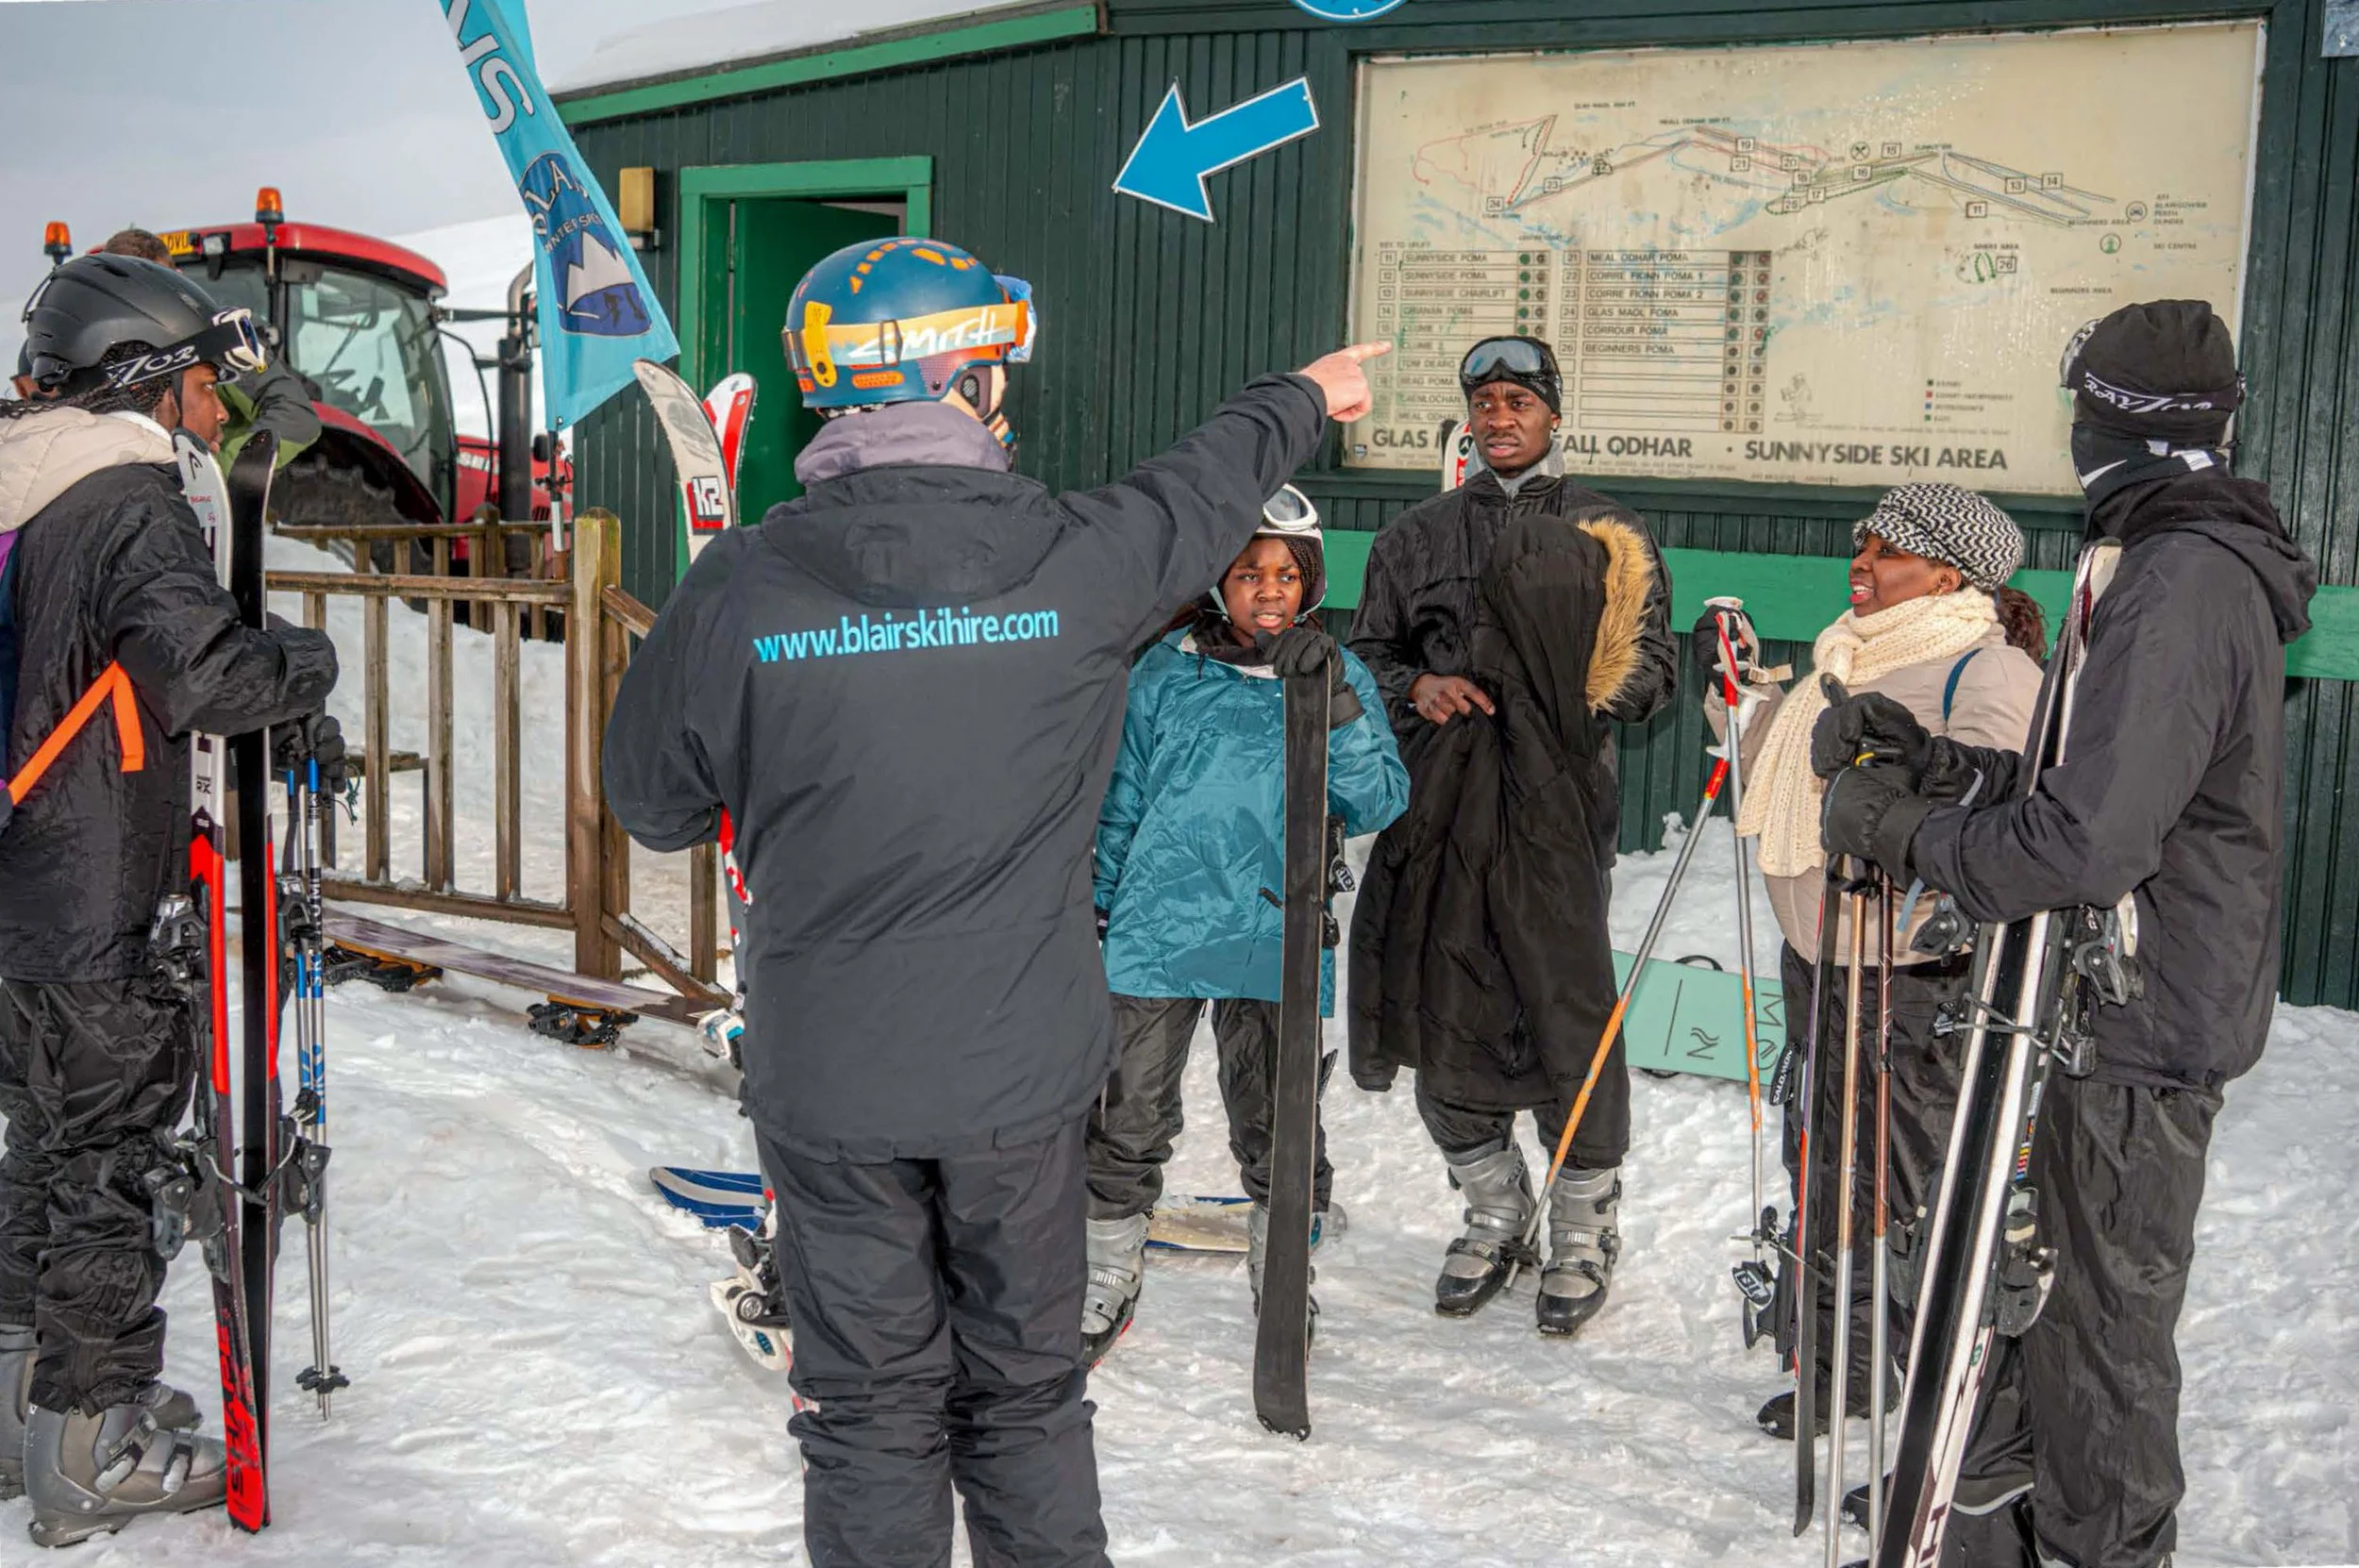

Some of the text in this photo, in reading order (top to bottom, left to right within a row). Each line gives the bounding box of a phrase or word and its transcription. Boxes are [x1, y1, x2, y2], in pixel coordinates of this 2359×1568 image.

[1459, 289, 1507, 298] CHAIRLIFT
[1663, 290, 1693, 299] POMA
[1587, 308, 1614, 317] GLAS
[1585, 344, 1641, 354] BEGINNERS
[1645, 344, 1675, 354] POMA
[1373, 428, 1429, 449] GLAS
[1606, 435, 1693, 458] ODHAR
[1745, 440, 1882, 466] SUNNYSIDE
[1889, 444, 1930, 467] SKI
[1935, 447, 2008, 470] AREA
[753, 606, 1060, 663] www.blairskihire.com
